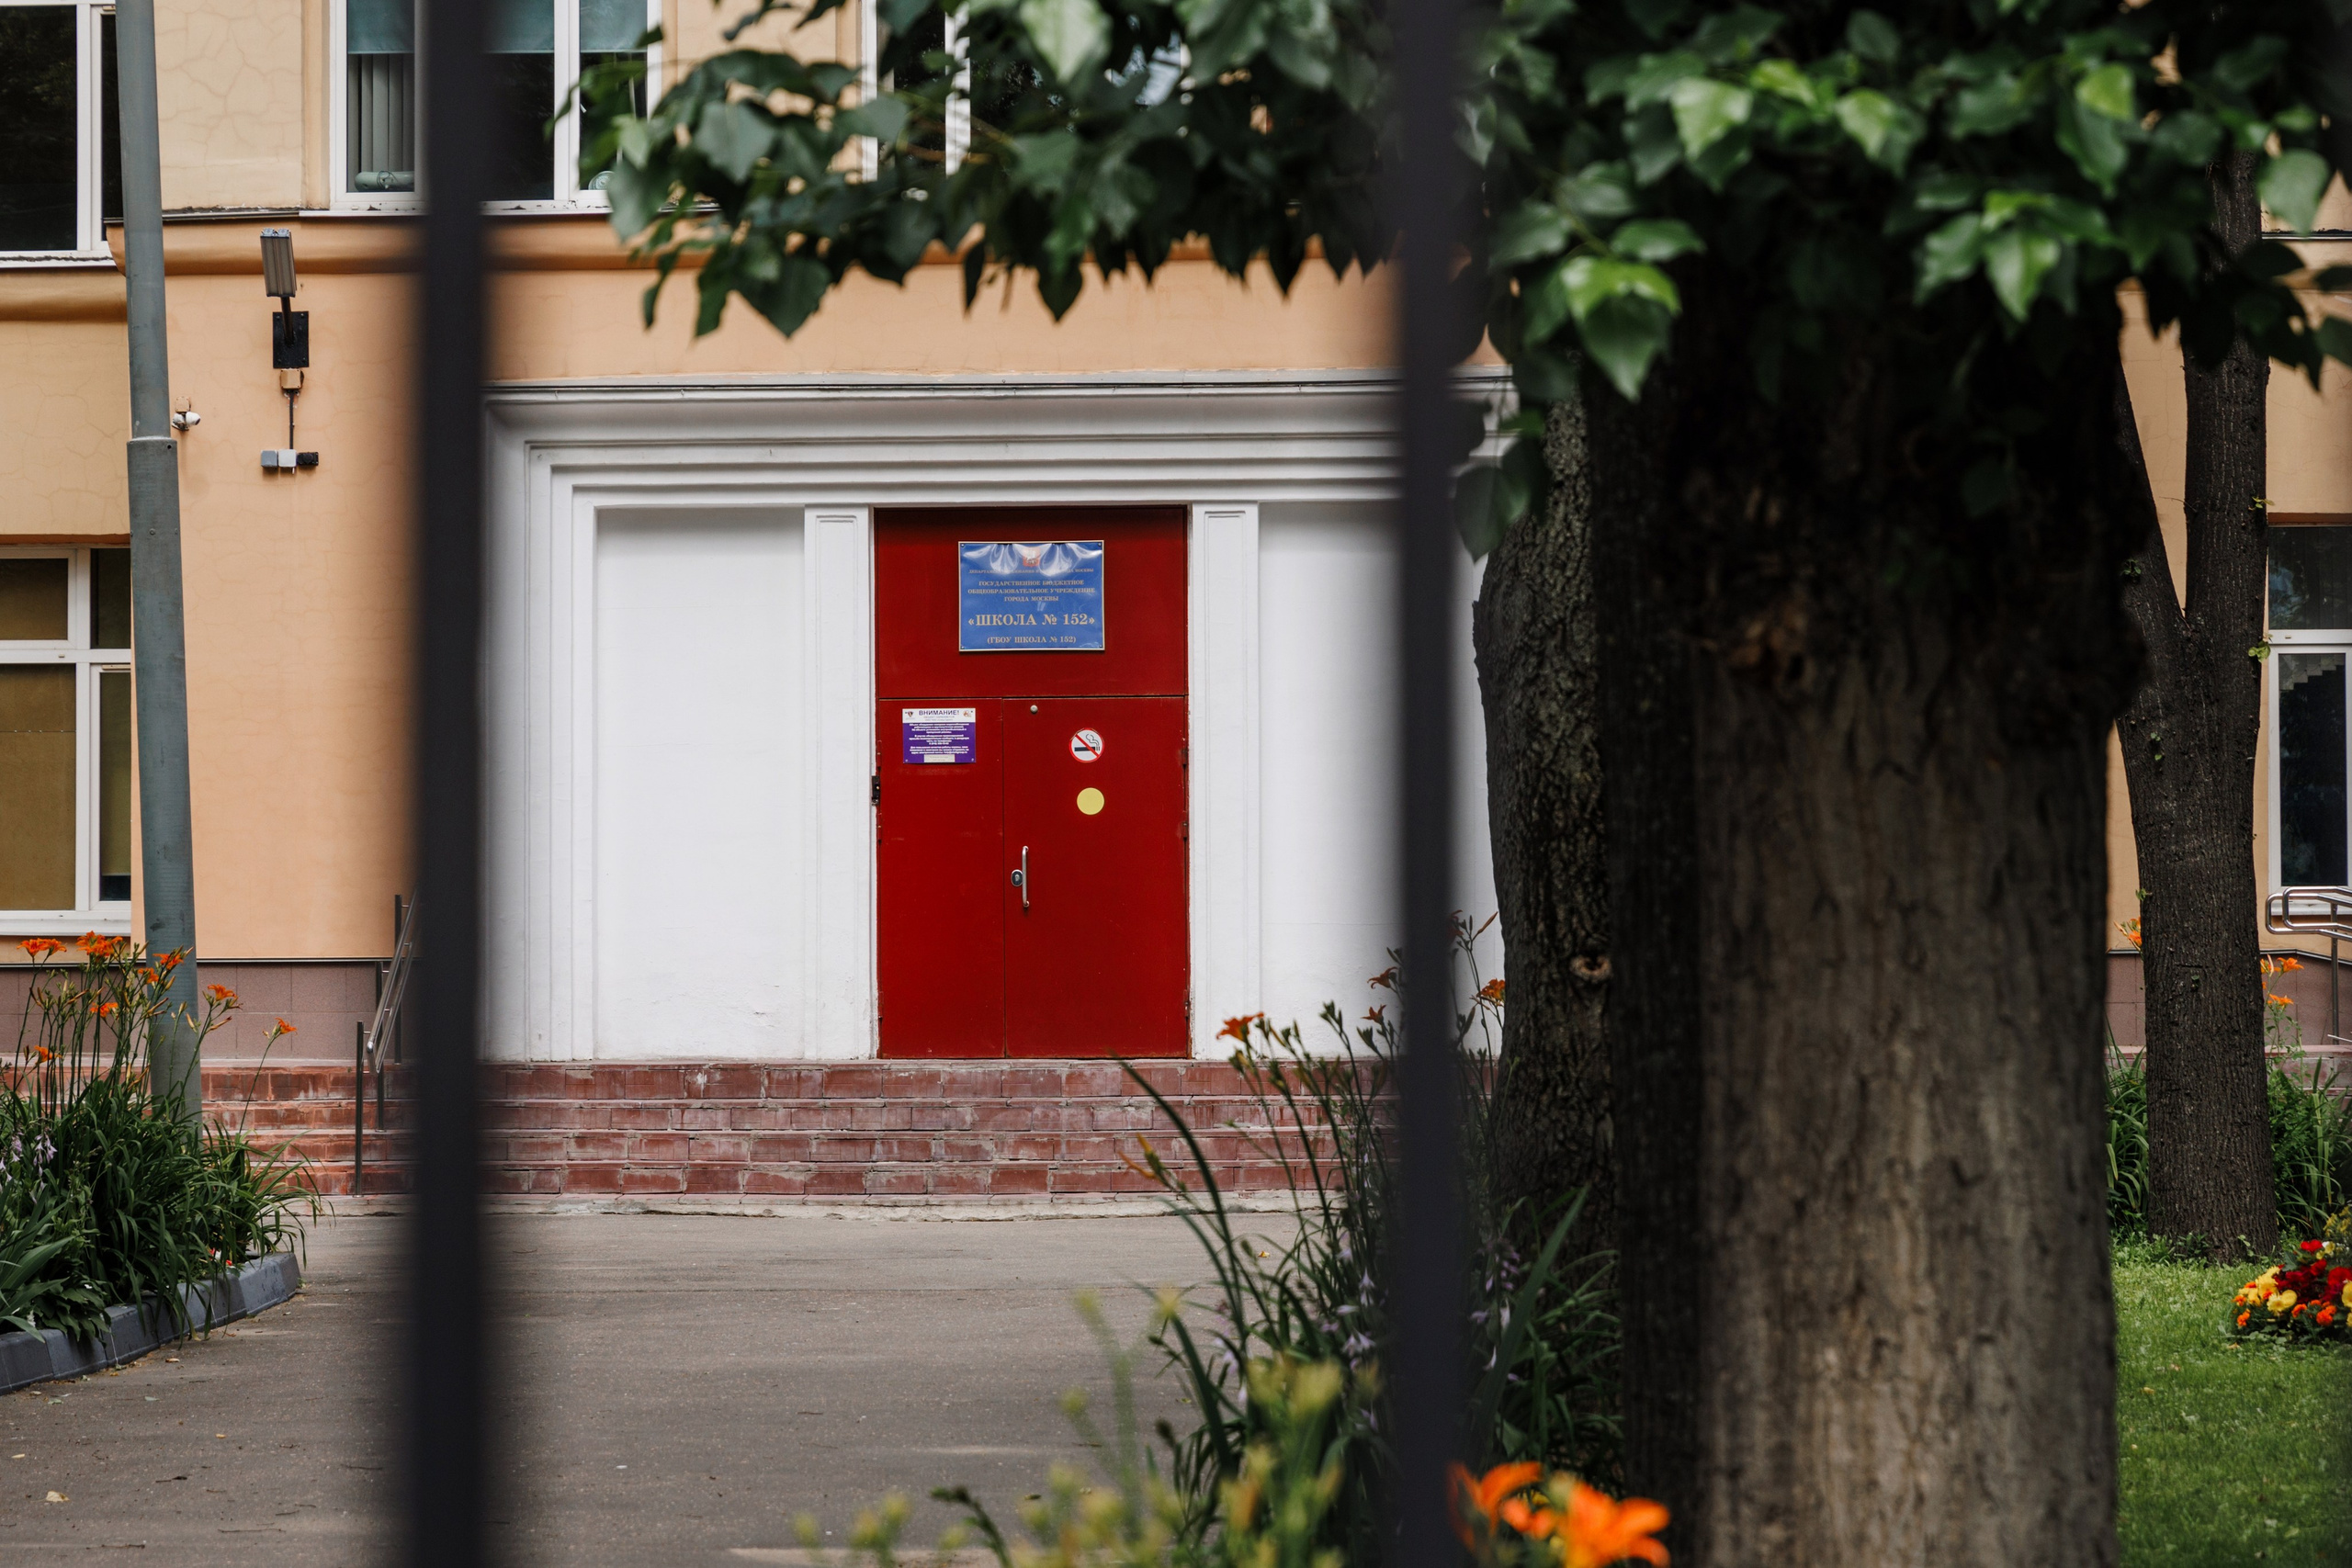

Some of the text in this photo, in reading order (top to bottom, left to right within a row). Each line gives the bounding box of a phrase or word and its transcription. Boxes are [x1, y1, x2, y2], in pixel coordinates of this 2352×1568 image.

[967, 614, 1095, 626] «ШКОЛА № 152»
[987, 636, 1012, 645] (ГБОУ
